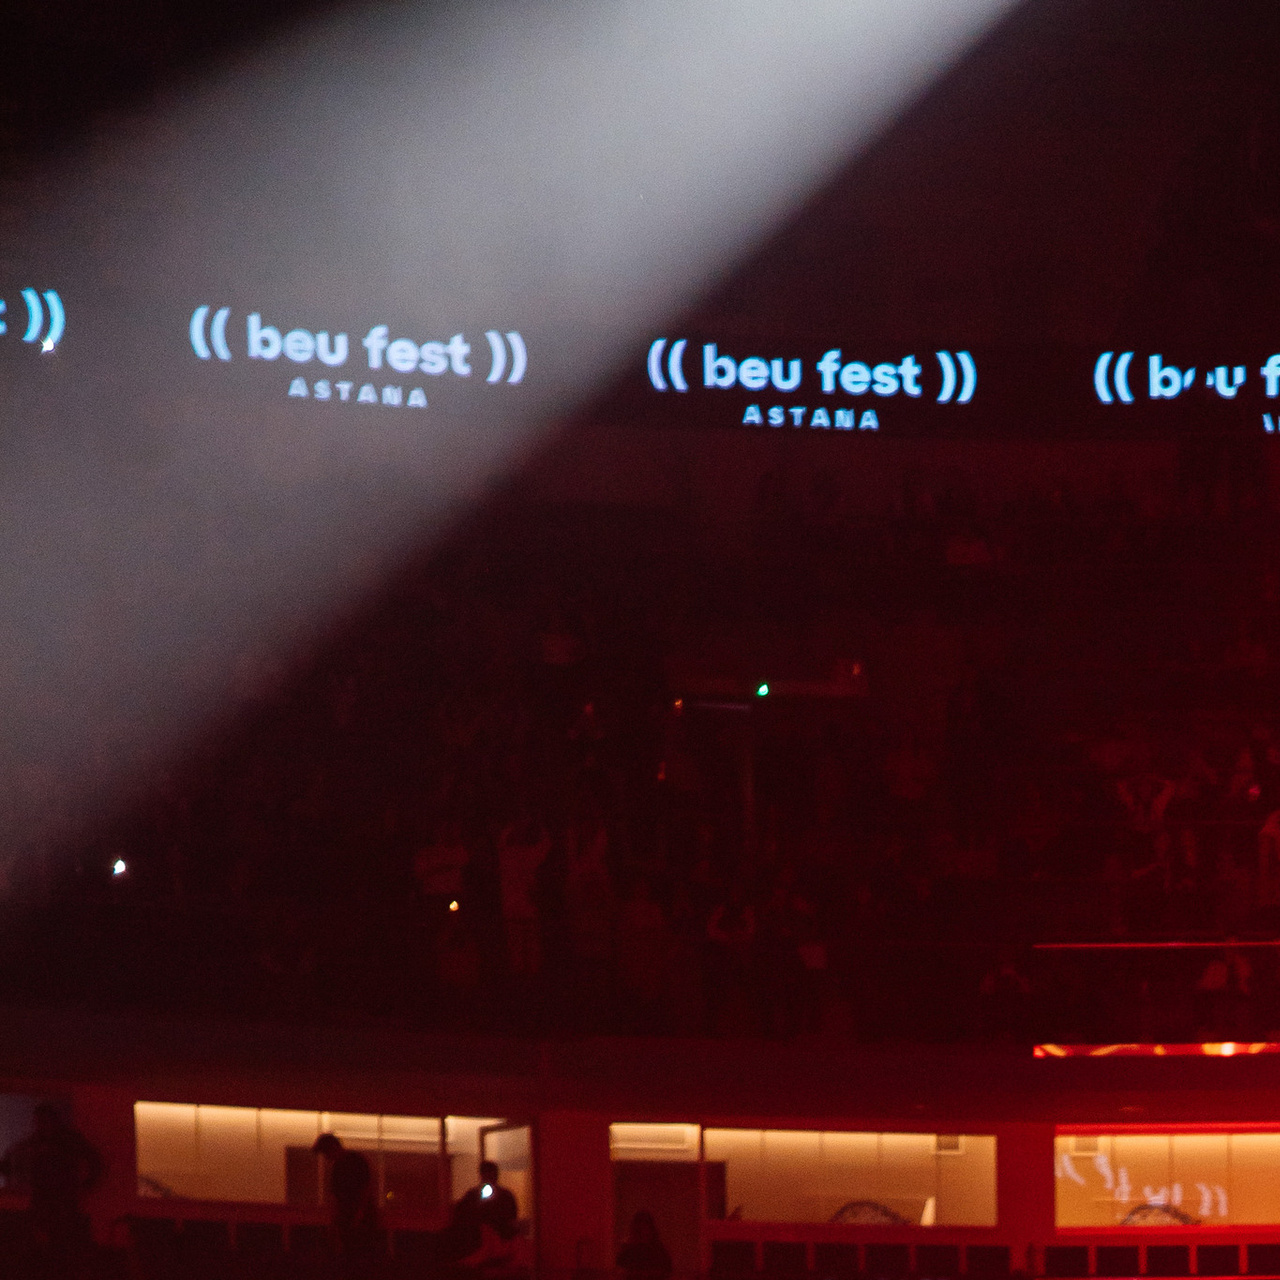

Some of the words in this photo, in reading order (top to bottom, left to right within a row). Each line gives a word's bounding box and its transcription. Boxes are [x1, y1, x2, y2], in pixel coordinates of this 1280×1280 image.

[246, 312, 350, 367] beu
[361, 323, 472, 378] fest
[287, 376, 428, 408] ASTANA
[702, 342, 803, 393] beu
[815, 348, 923, 398] fest
[741, 404, 880, 431] ASTANA
